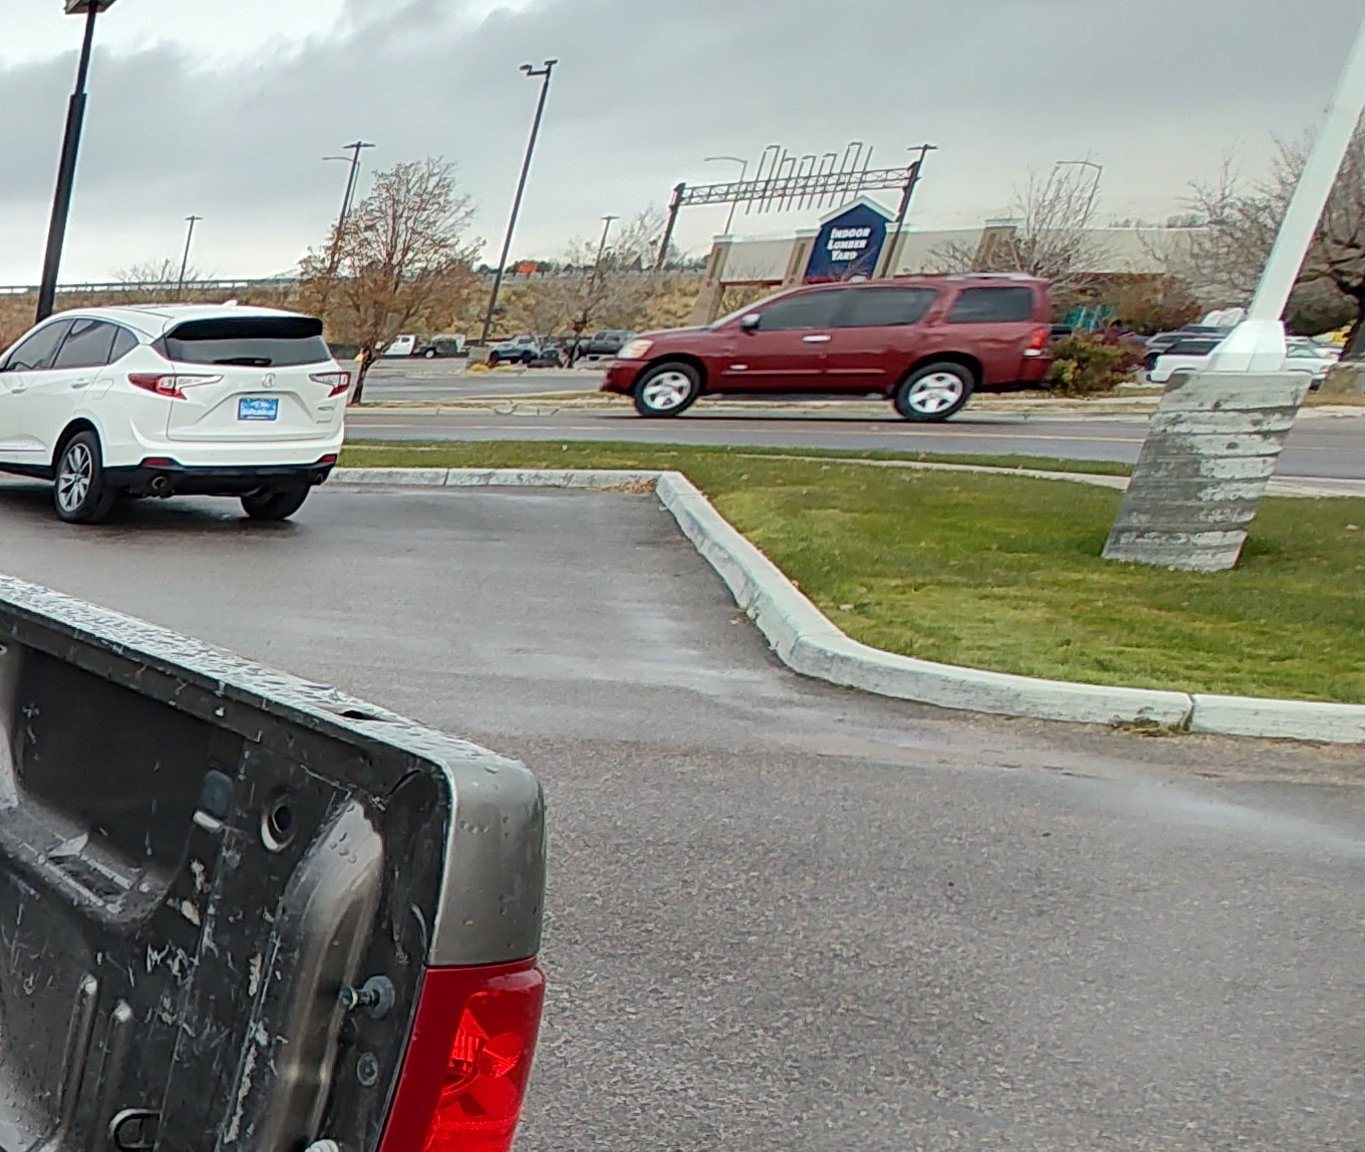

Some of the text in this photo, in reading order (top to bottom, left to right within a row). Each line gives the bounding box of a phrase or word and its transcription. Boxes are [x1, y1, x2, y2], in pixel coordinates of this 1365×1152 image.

[831, 227, 871, 239] INDOOR
[827, 239, 867, 250] LUMBER
[831, 250, 858, 261] YARD
